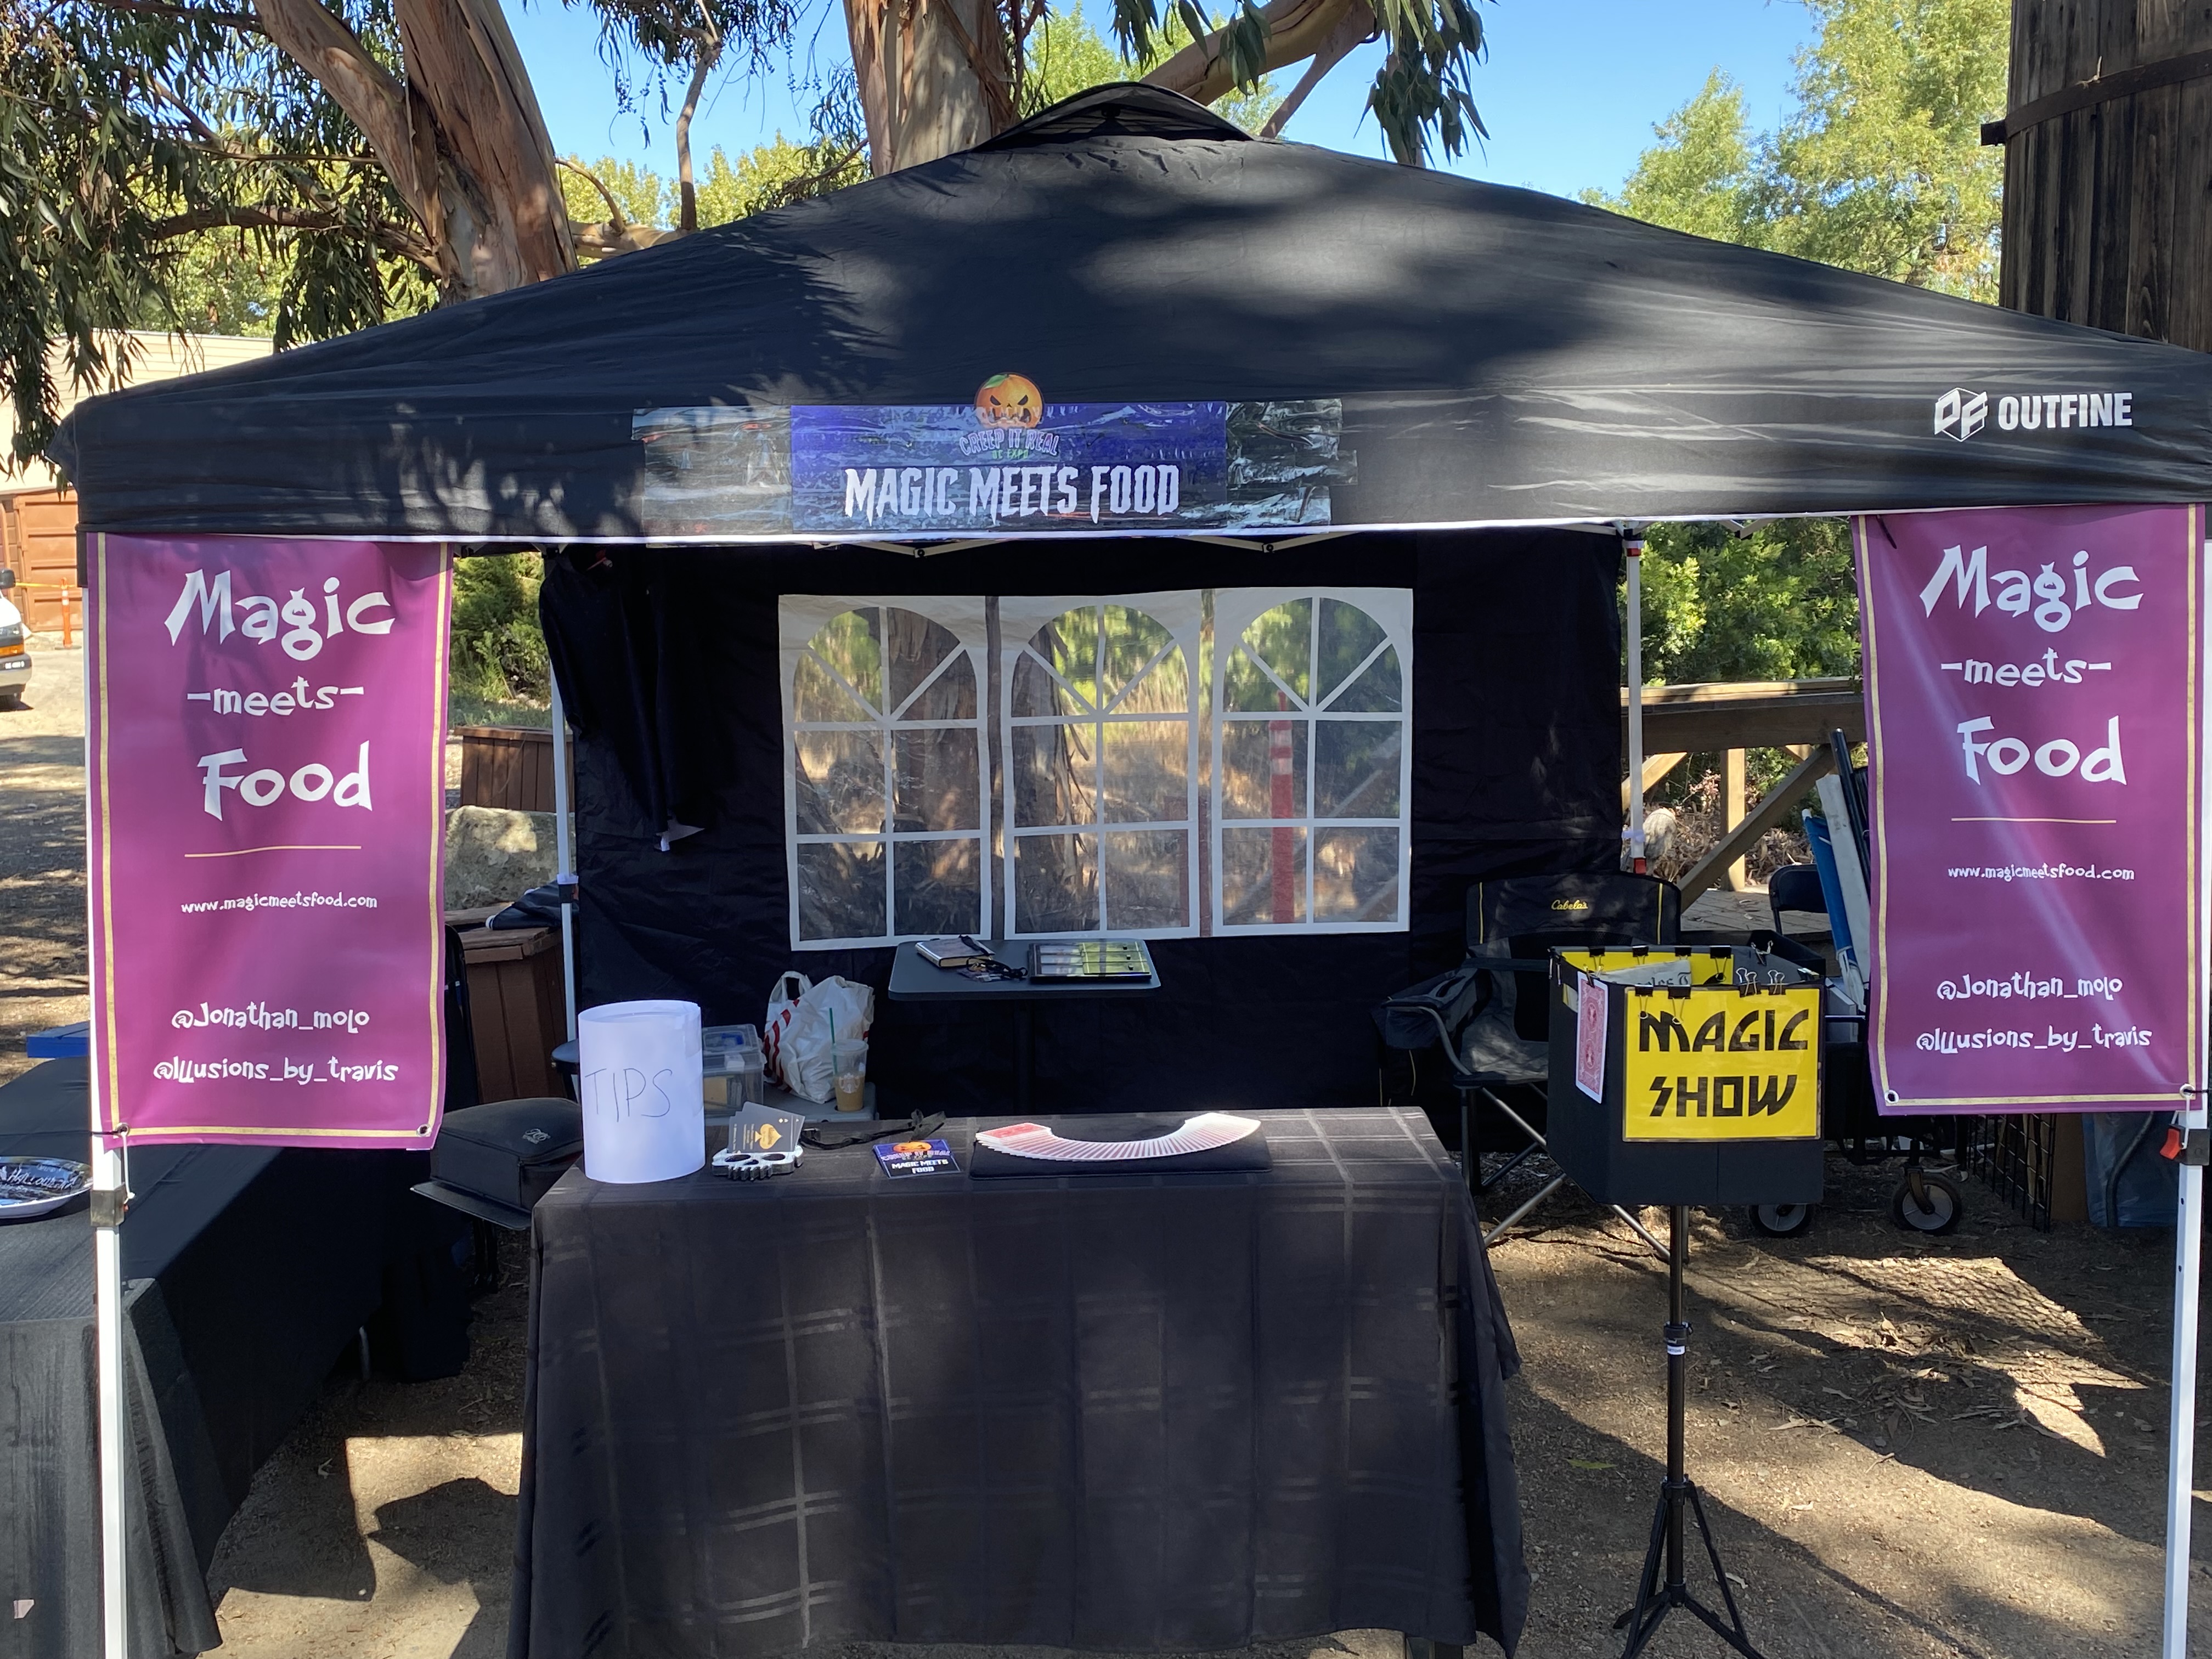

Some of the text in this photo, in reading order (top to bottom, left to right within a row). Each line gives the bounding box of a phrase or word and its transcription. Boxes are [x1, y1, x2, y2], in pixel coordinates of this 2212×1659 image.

[1998, 392, 2132, 431] OUTFINE
[960, 428, 1059, 456] CREEP IT REAL
[1007, 449, 1029, 459] EXPO
[845, 464, 1180, 526] MAGIC MEETS FOOD
[1919, 545, 2144, 633] Magic
[165, 569, 396, 661] Magic
[1957, 715, 2127, 786] Food
[197, 740, 373, 821] Food
[1948, 862, 2135, 882] www.magicmeetsfood.com
[181, 891, 377, 913] www.magicmeetsfood.com
[1639, 1009, 1809, 1052] MAGIC
[585, 1068, 673, 1122] TIPS
[1649, 1075, 1797, 1117] SHOW
[912, 1166, 934, 1174] FOOD
[920, 1159, 949, 1167] MEETS
